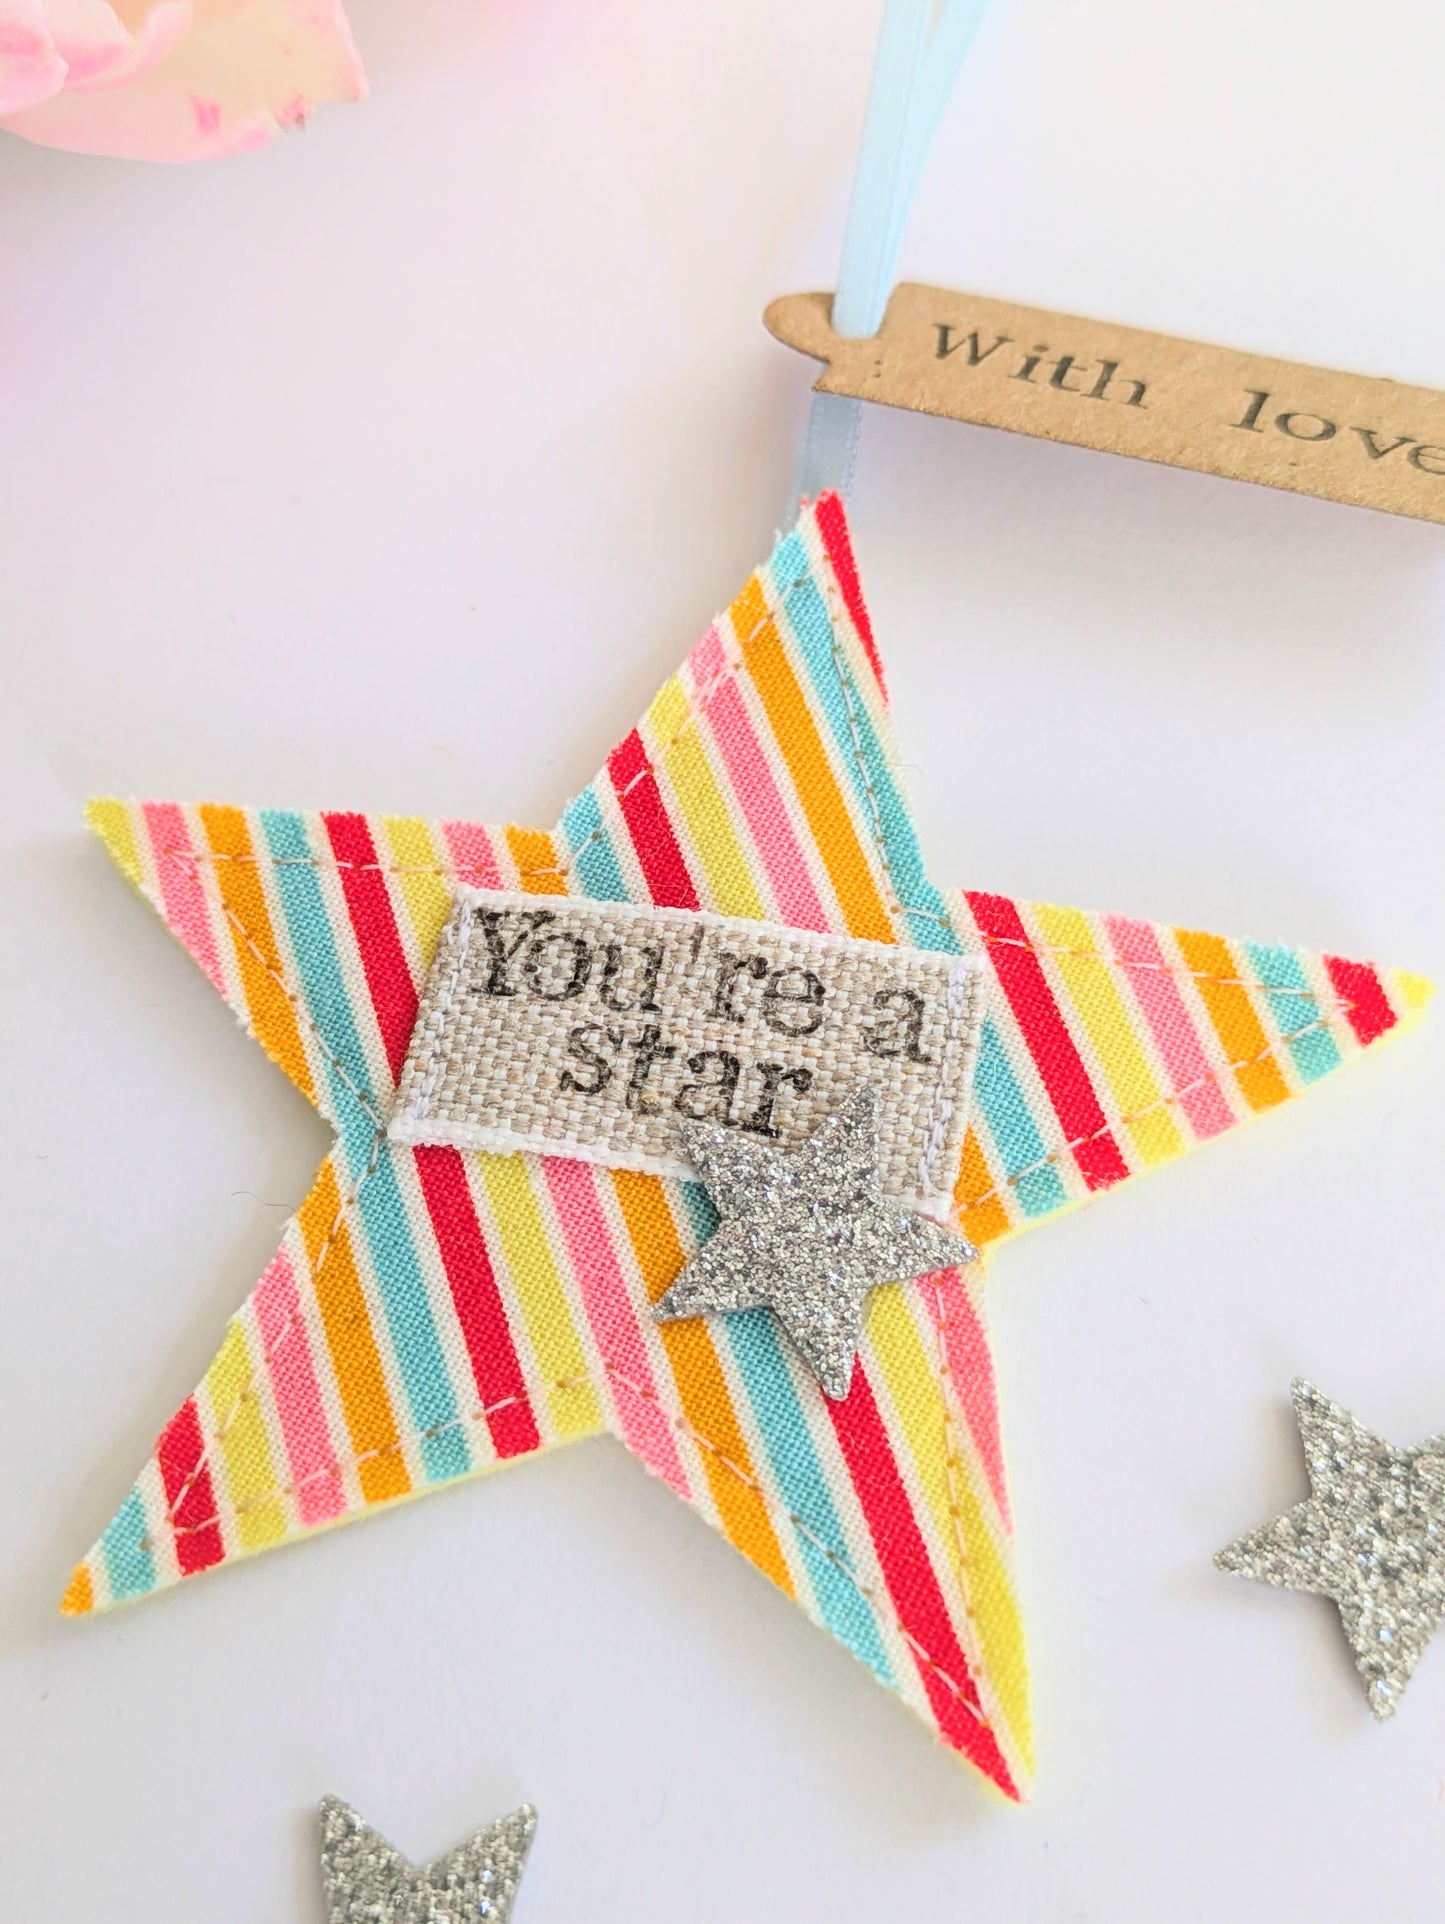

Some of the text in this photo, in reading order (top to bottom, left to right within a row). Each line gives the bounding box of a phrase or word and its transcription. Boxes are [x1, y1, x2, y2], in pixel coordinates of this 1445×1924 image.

[932, 322, 1445, 476] With love
[471, 906, 932, 1064] You're a
[559, 1023, 813, 1139] star
